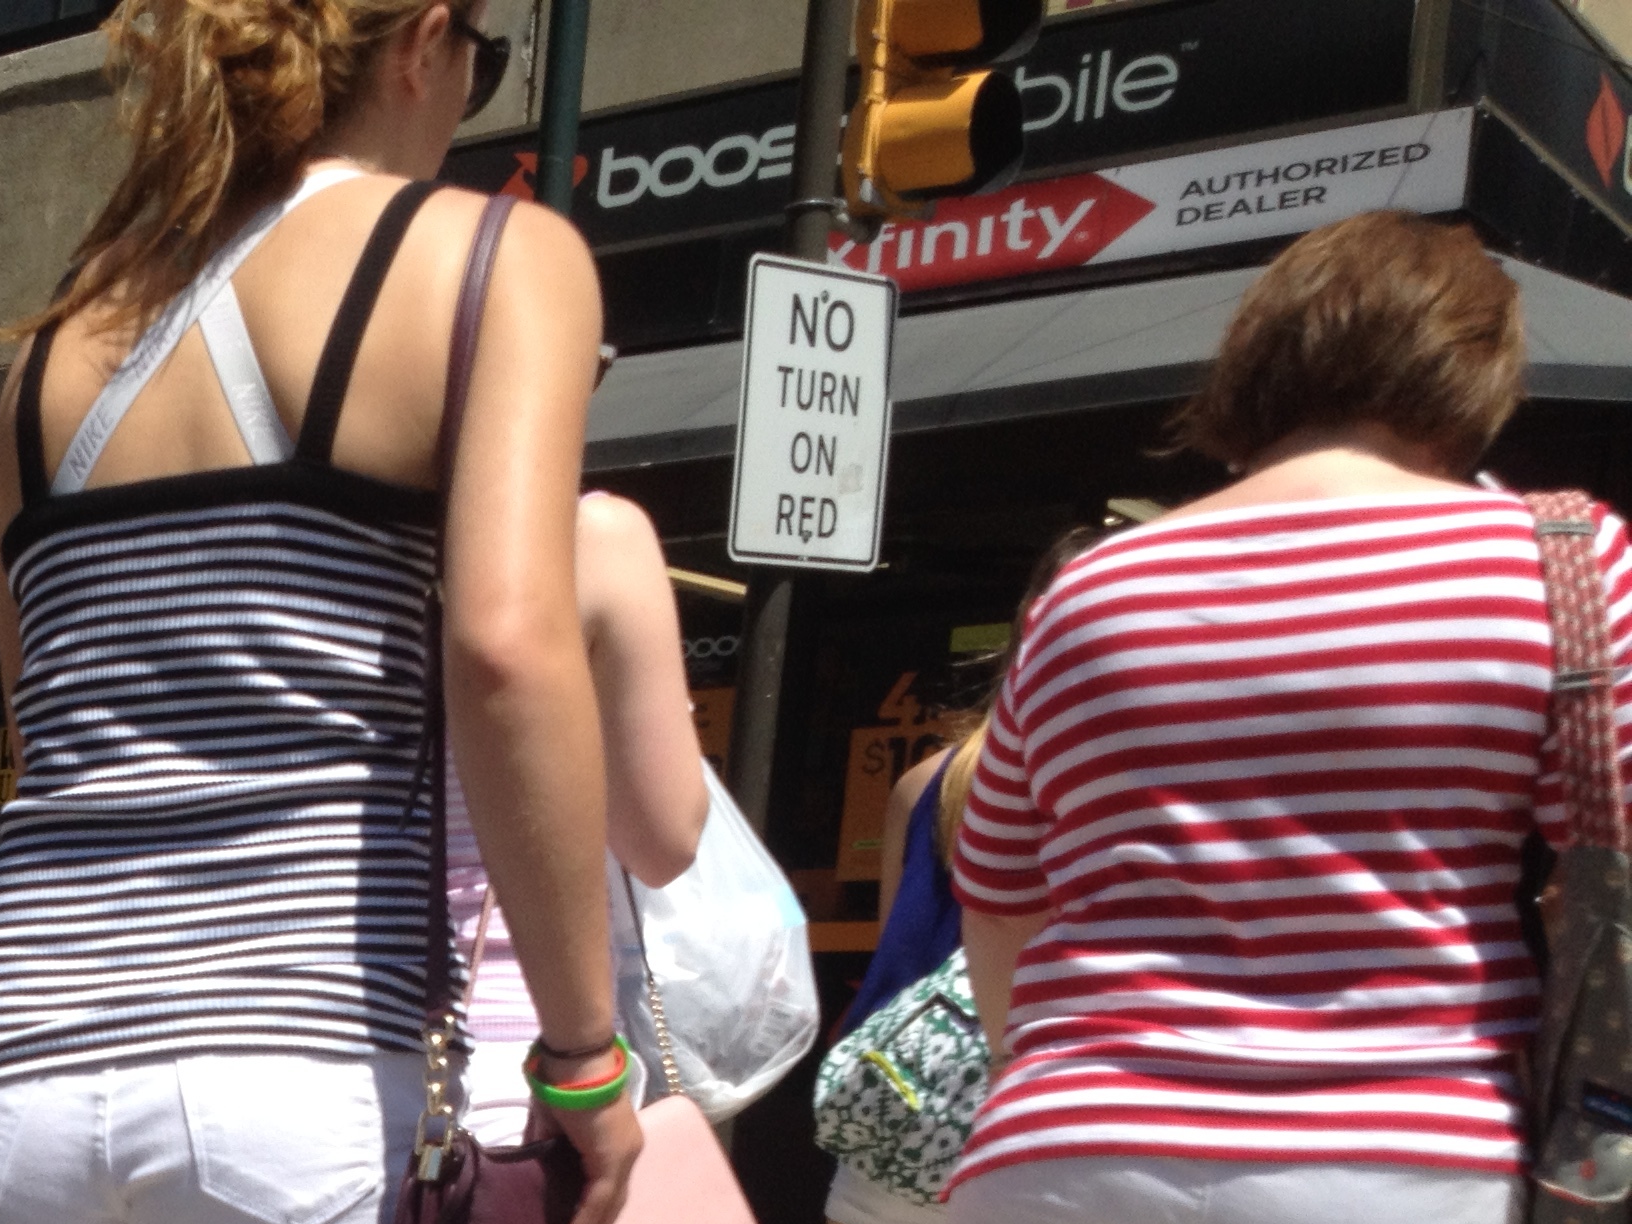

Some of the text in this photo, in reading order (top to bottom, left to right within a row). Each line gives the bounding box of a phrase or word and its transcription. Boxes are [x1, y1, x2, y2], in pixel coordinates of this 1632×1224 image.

[597, 49, 1179, 209] boos bile
[1179, 142, 1432, 200] AUTHORIZED
[1176, 186, 1327, 227] DEALER
[789, 292, 855, 352] NO
[776, 365, 861, 416] TURN
[790, 431, 837, 476] ON
[775, 493, 838, 539] RED
